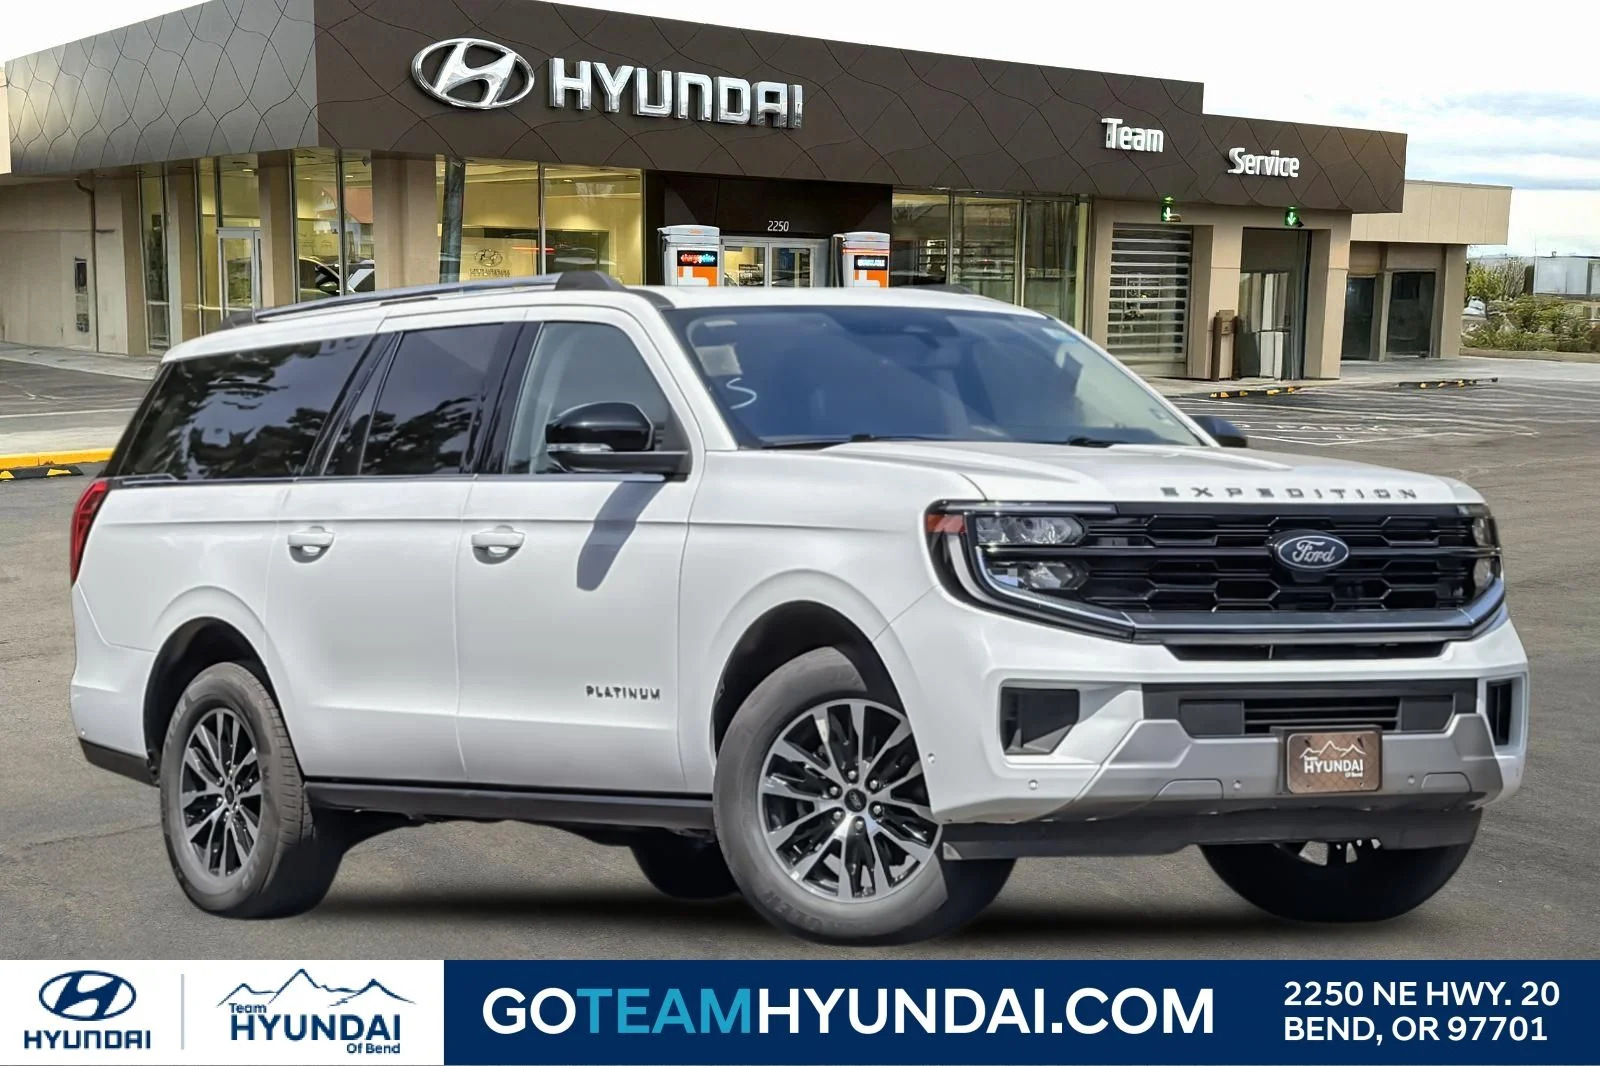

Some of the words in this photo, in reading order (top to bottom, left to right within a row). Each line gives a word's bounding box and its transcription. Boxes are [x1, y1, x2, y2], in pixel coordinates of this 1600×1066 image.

[548, 57, 803, 129] HYUNDAI
[1101, 117, 1164, 152] Team
[1227, 147, 1300, 178] Service
[767, 220, 790, 232] 2250
[1160, 486, 1417, 499] EXPEDITION
[1291, 540, 1335, 563] Ford
[586, 685, 661, 700] PLATINUM
[1304, 759, 1363, 774] HYUNDAI
